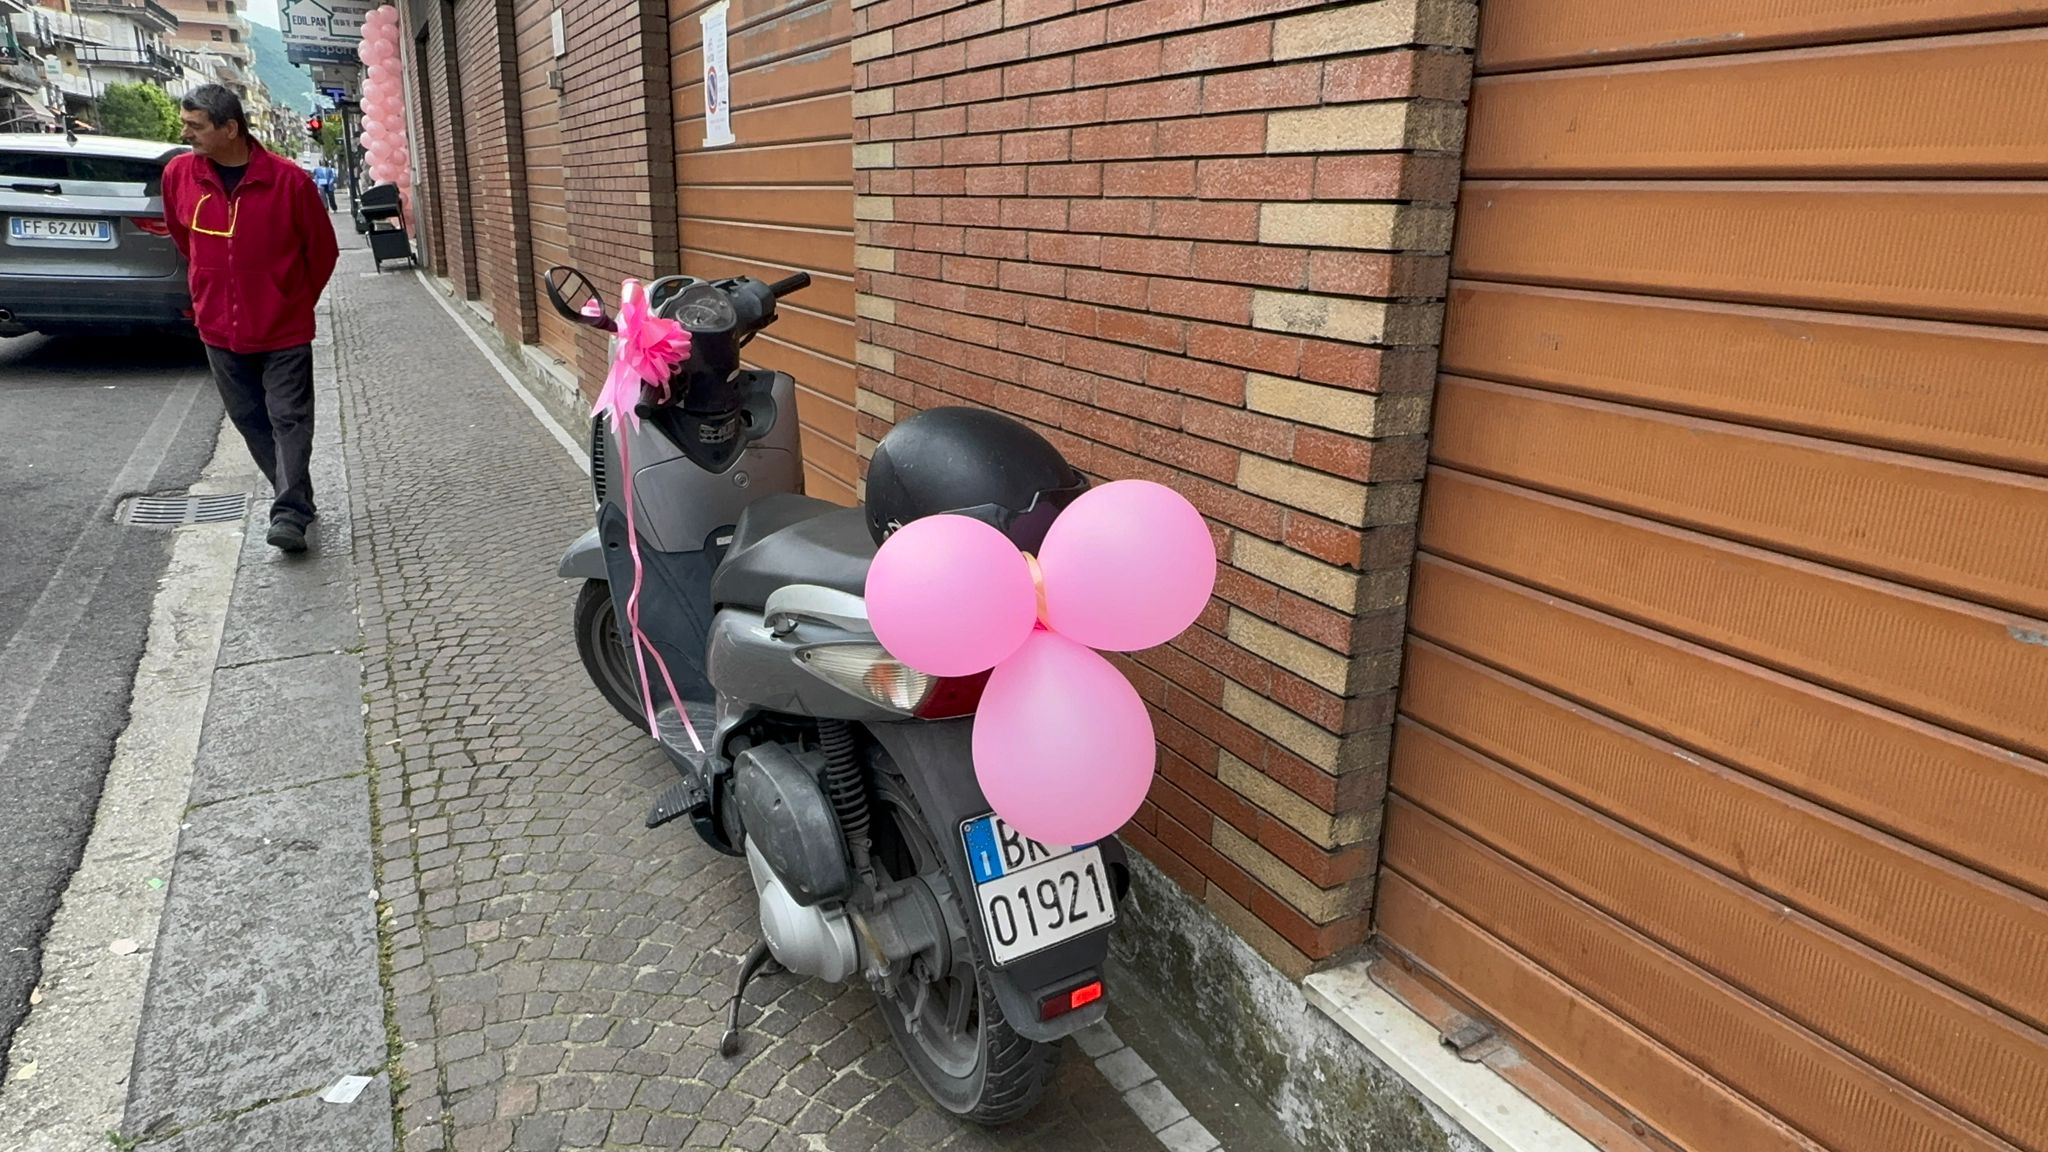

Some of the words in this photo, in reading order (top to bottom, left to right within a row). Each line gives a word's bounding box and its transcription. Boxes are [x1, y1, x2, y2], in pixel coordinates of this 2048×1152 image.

[23, 220, 42, 234] FF
[48, 221, 97, 236] 624WV
[989, 862, 1105, 946] 01921
